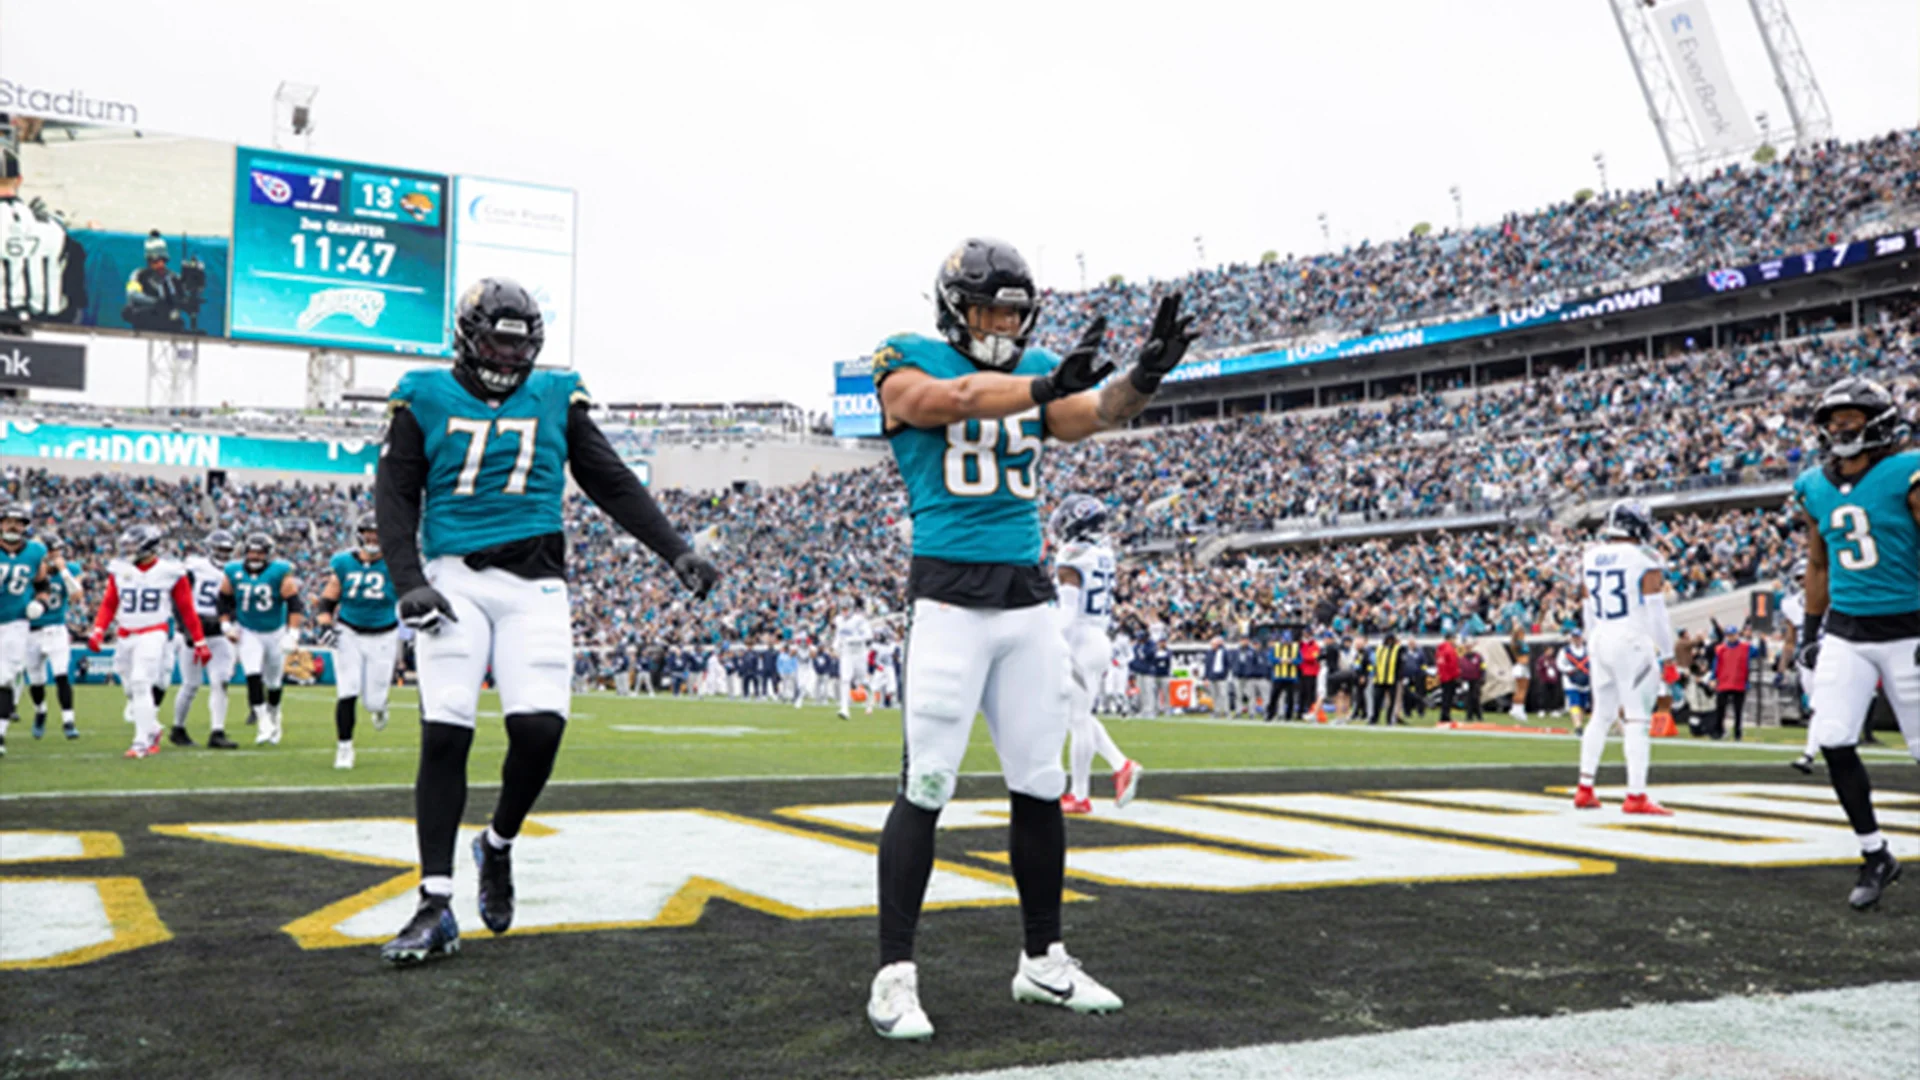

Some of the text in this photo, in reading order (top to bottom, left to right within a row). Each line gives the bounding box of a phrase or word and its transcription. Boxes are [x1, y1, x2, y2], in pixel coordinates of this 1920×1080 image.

[0, 78, 139, 125] Stadium
[1676, 36, 1732, 137] EverBank
[309, 176, 326, 200] 7
[362, 183, 393, 209] 13
[5, 236, 40, 258] 67
[291, 233, 396, 277] 11:47
[1833, 243, 1849, 267] 7
[446, 416, 539, 496] 77
[942, 404, 1042, 499] 85
[1830, 505, 1879, 570] 3
[120, 588, 161, 613] 98
[237, 583, 273, 612] 73
[345, 571, 385, 600] 72
[1585, 568, 1629, 620] 33
